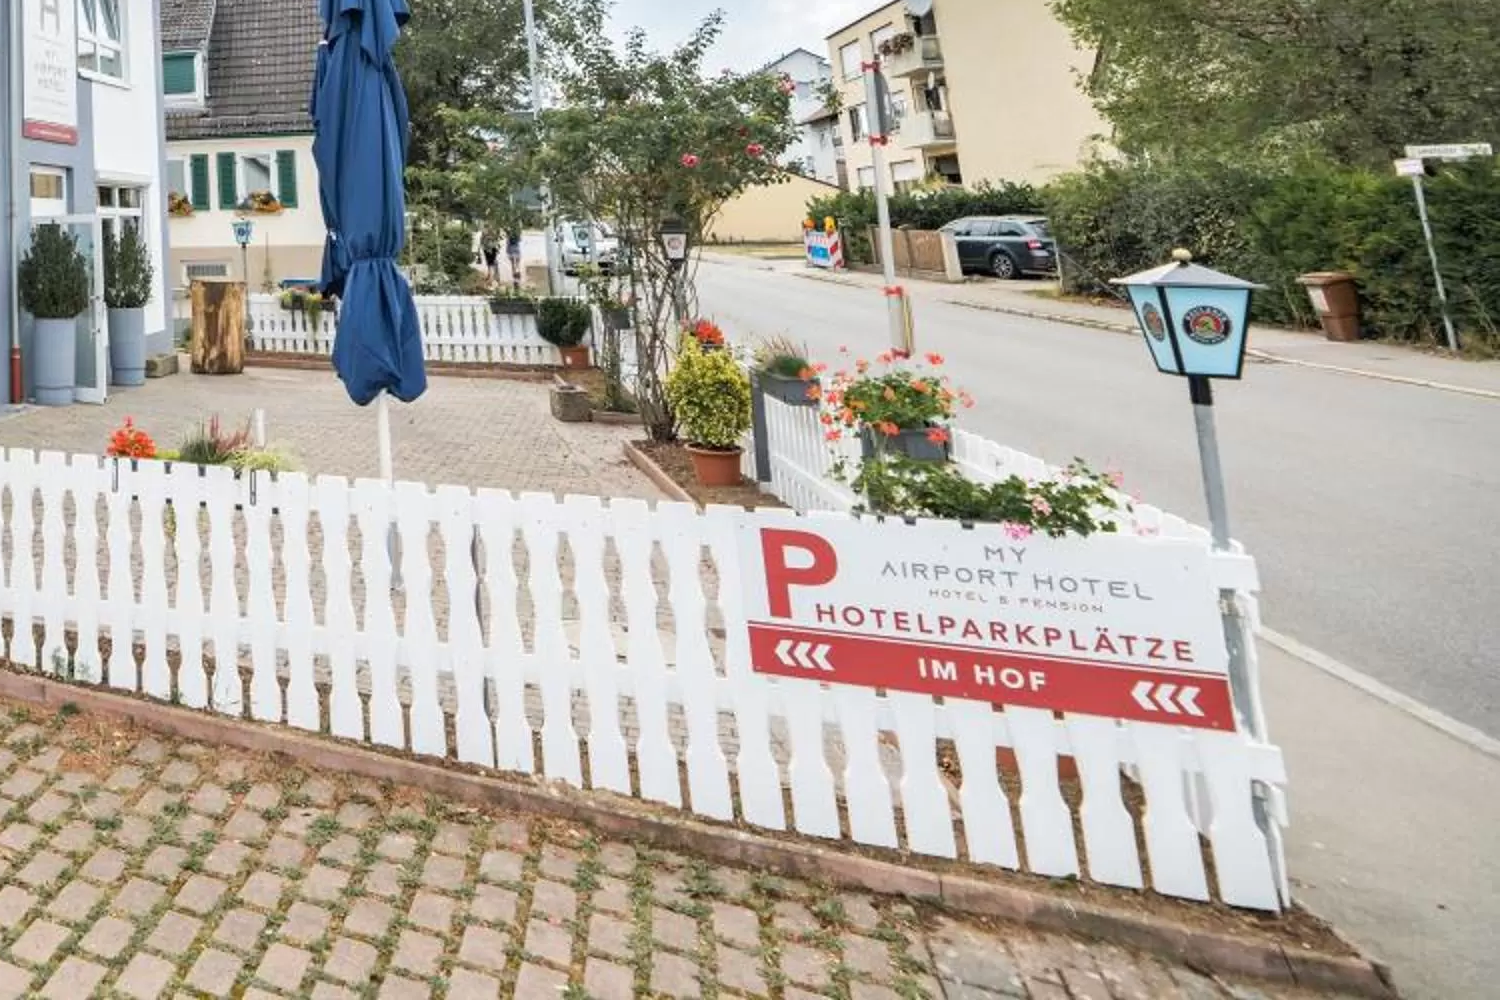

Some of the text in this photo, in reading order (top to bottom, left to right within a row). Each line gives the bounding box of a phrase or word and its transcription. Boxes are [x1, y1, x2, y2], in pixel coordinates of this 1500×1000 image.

[760, 527, 838, 619] P
[983, 545, 1027, 564] MY
[880, 561, 1153, 600] AIRPORT HOTEL
[928, 588, 988, 604] HOTEL
[1018, 597, 1104, 614] PENSION
[815, 603, 1194, 663] HOTELPARKPLÄTZE
[918, 657, 1047, 692] IM HOF
